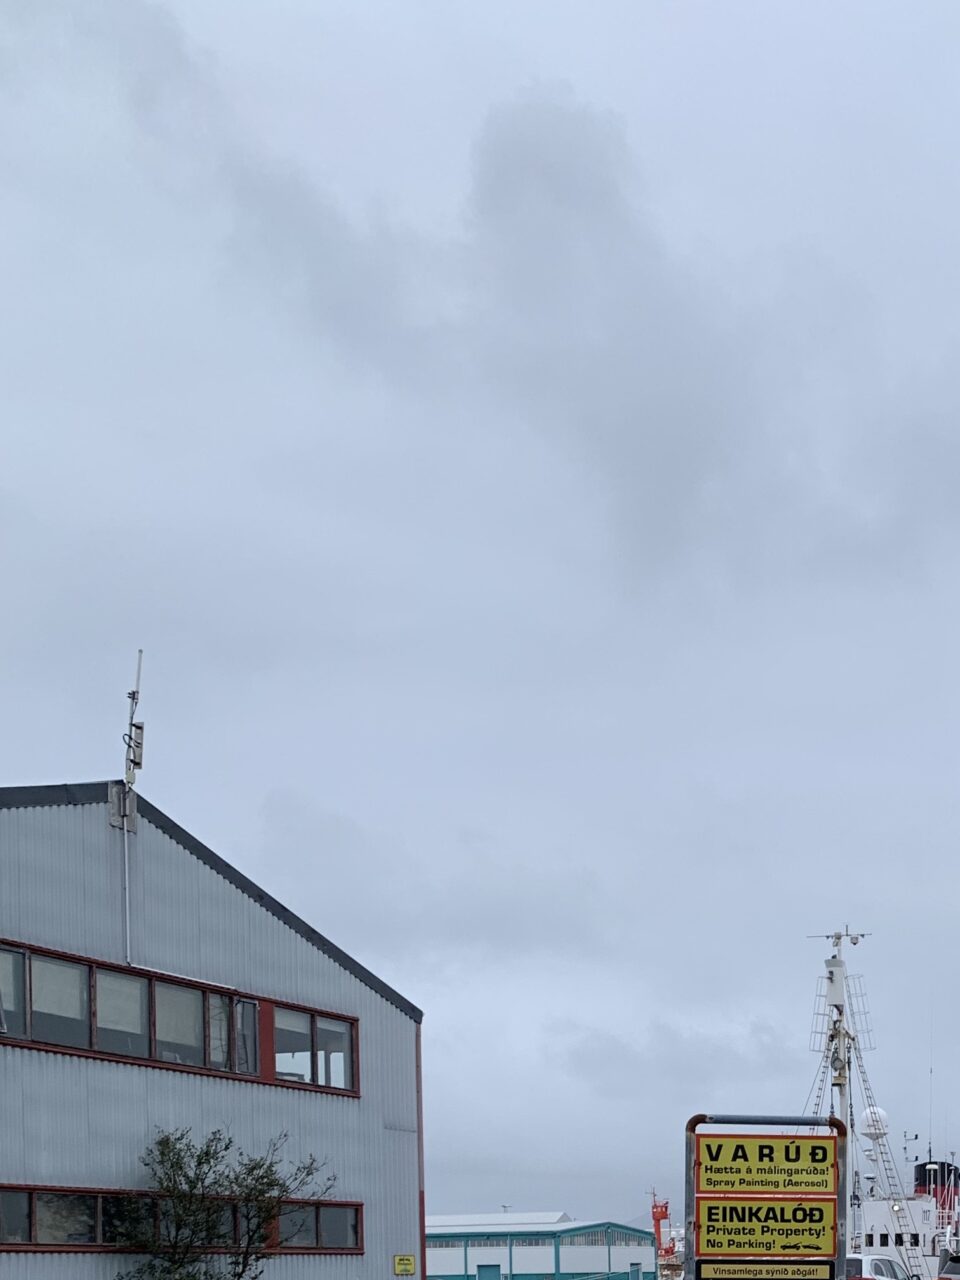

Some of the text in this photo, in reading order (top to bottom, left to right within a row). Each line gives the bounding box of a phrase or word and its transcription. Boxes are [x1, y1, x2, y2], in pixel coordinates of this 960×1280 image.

[704, 1165, 829, 1177] Hætta á málingarúða!
[706, 1178, 828, 1188] Spray Painting (Aerosol)
[706, 1203, 824, 1223] EINKALÓÐ
[706, 1225, 826, 1239] Private Property!
[706, 1239, 776, 1251] No Parking!
[712, 1267, 818, 1277] Vinsamlega sýnið aðgát!
